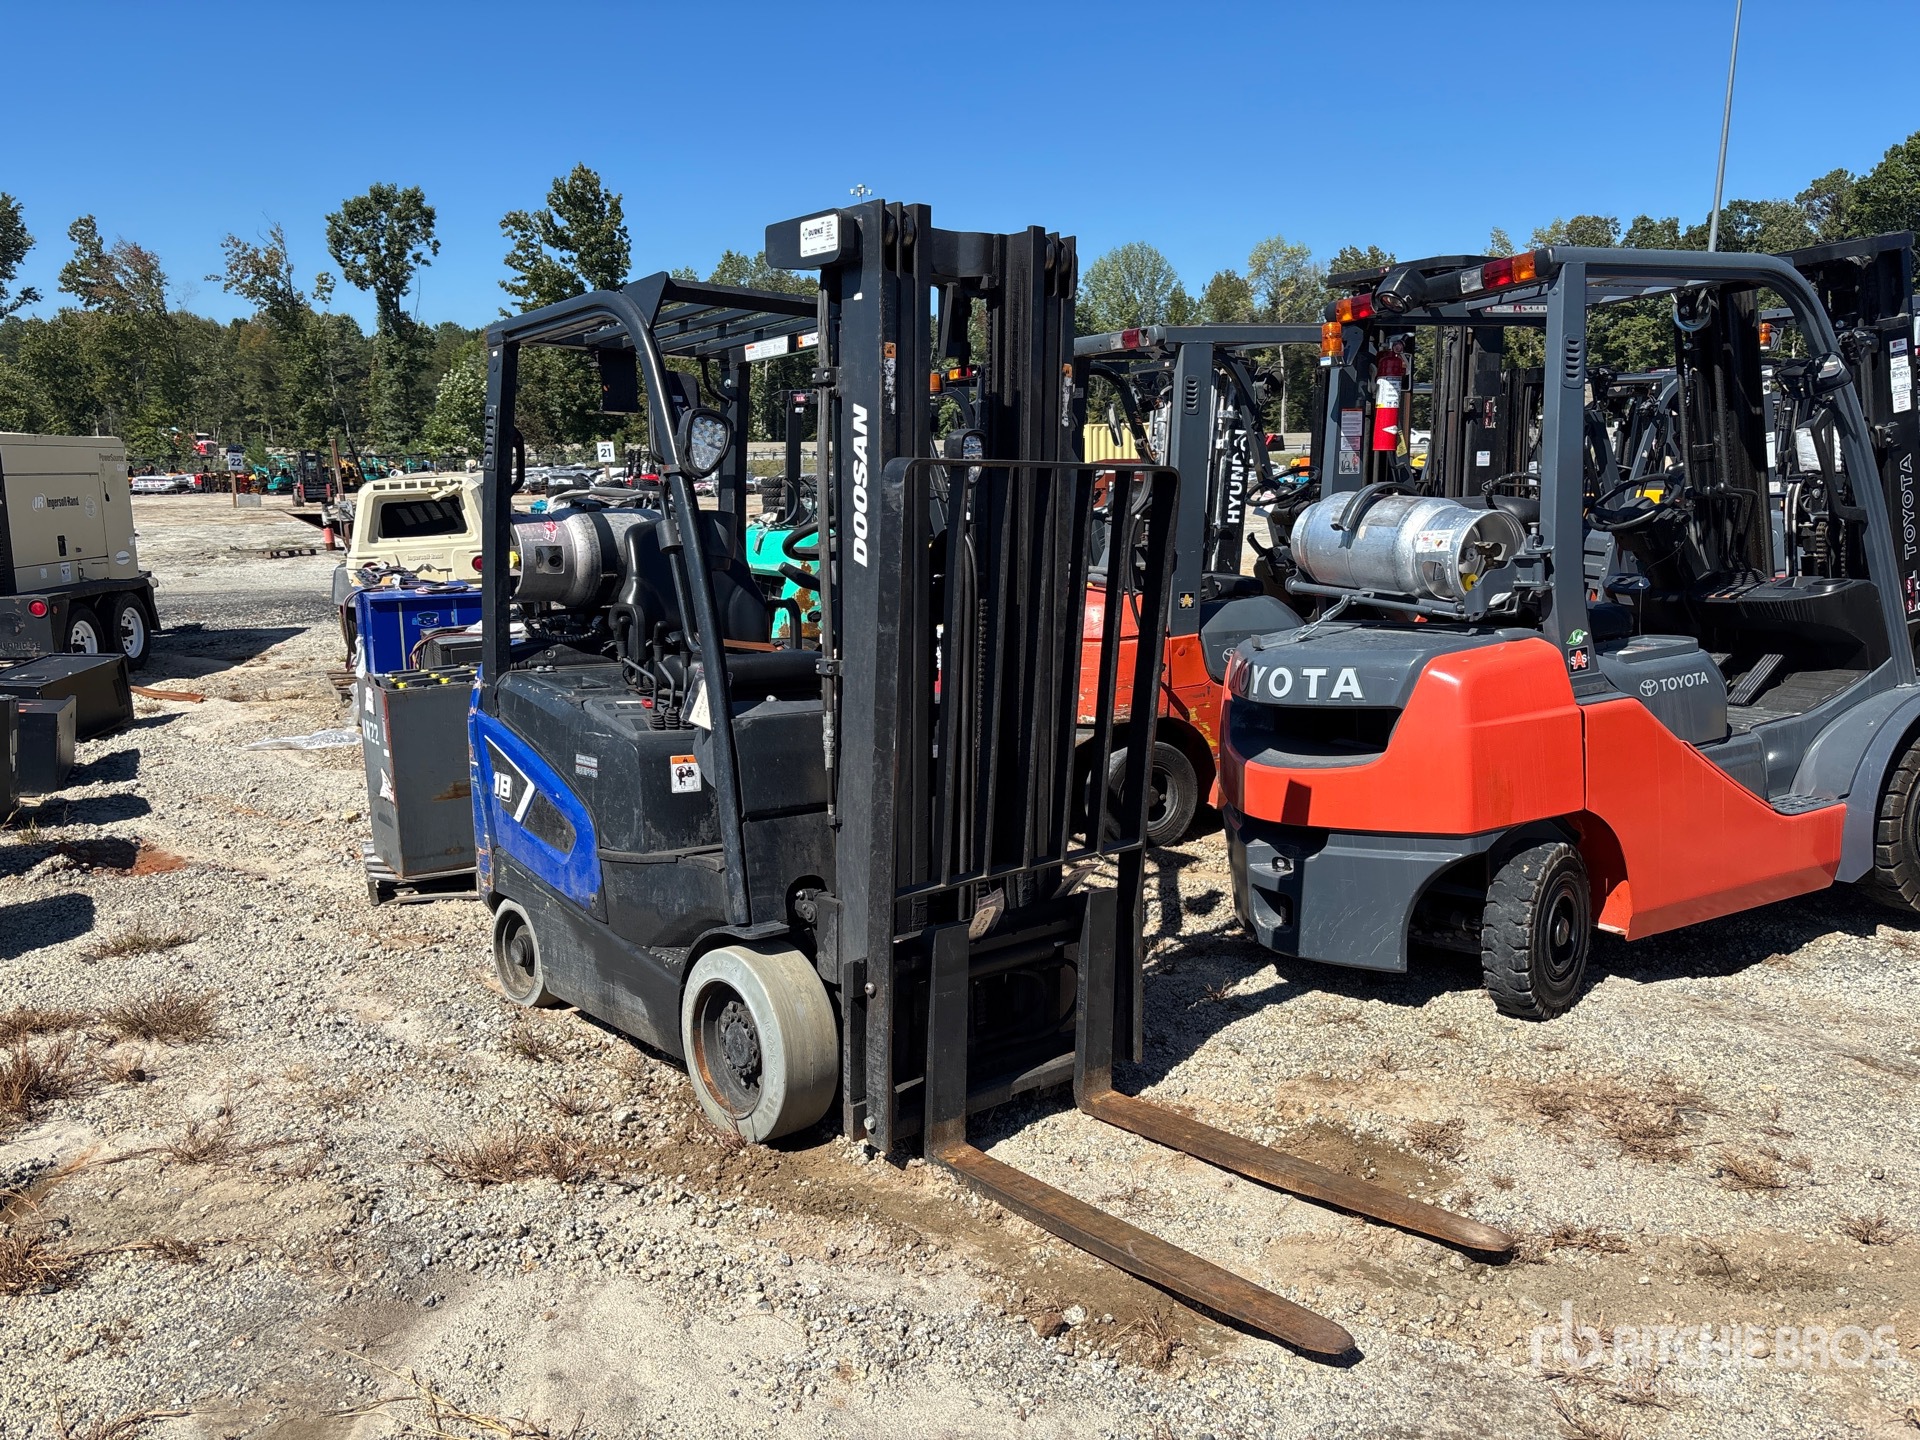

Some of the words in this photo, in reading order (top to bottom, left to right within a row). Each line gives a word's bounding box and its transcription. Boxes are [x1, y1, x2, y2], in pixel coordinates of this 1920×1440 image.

[230, 458, 242, 467] 22
[600, 448, 612, 458] 21
[853, 403, 868, 567] DOOSAN
[1900, 453, 1917, 560] TOYOTA
[1660, 671, 1710, 692] TOYOTA
